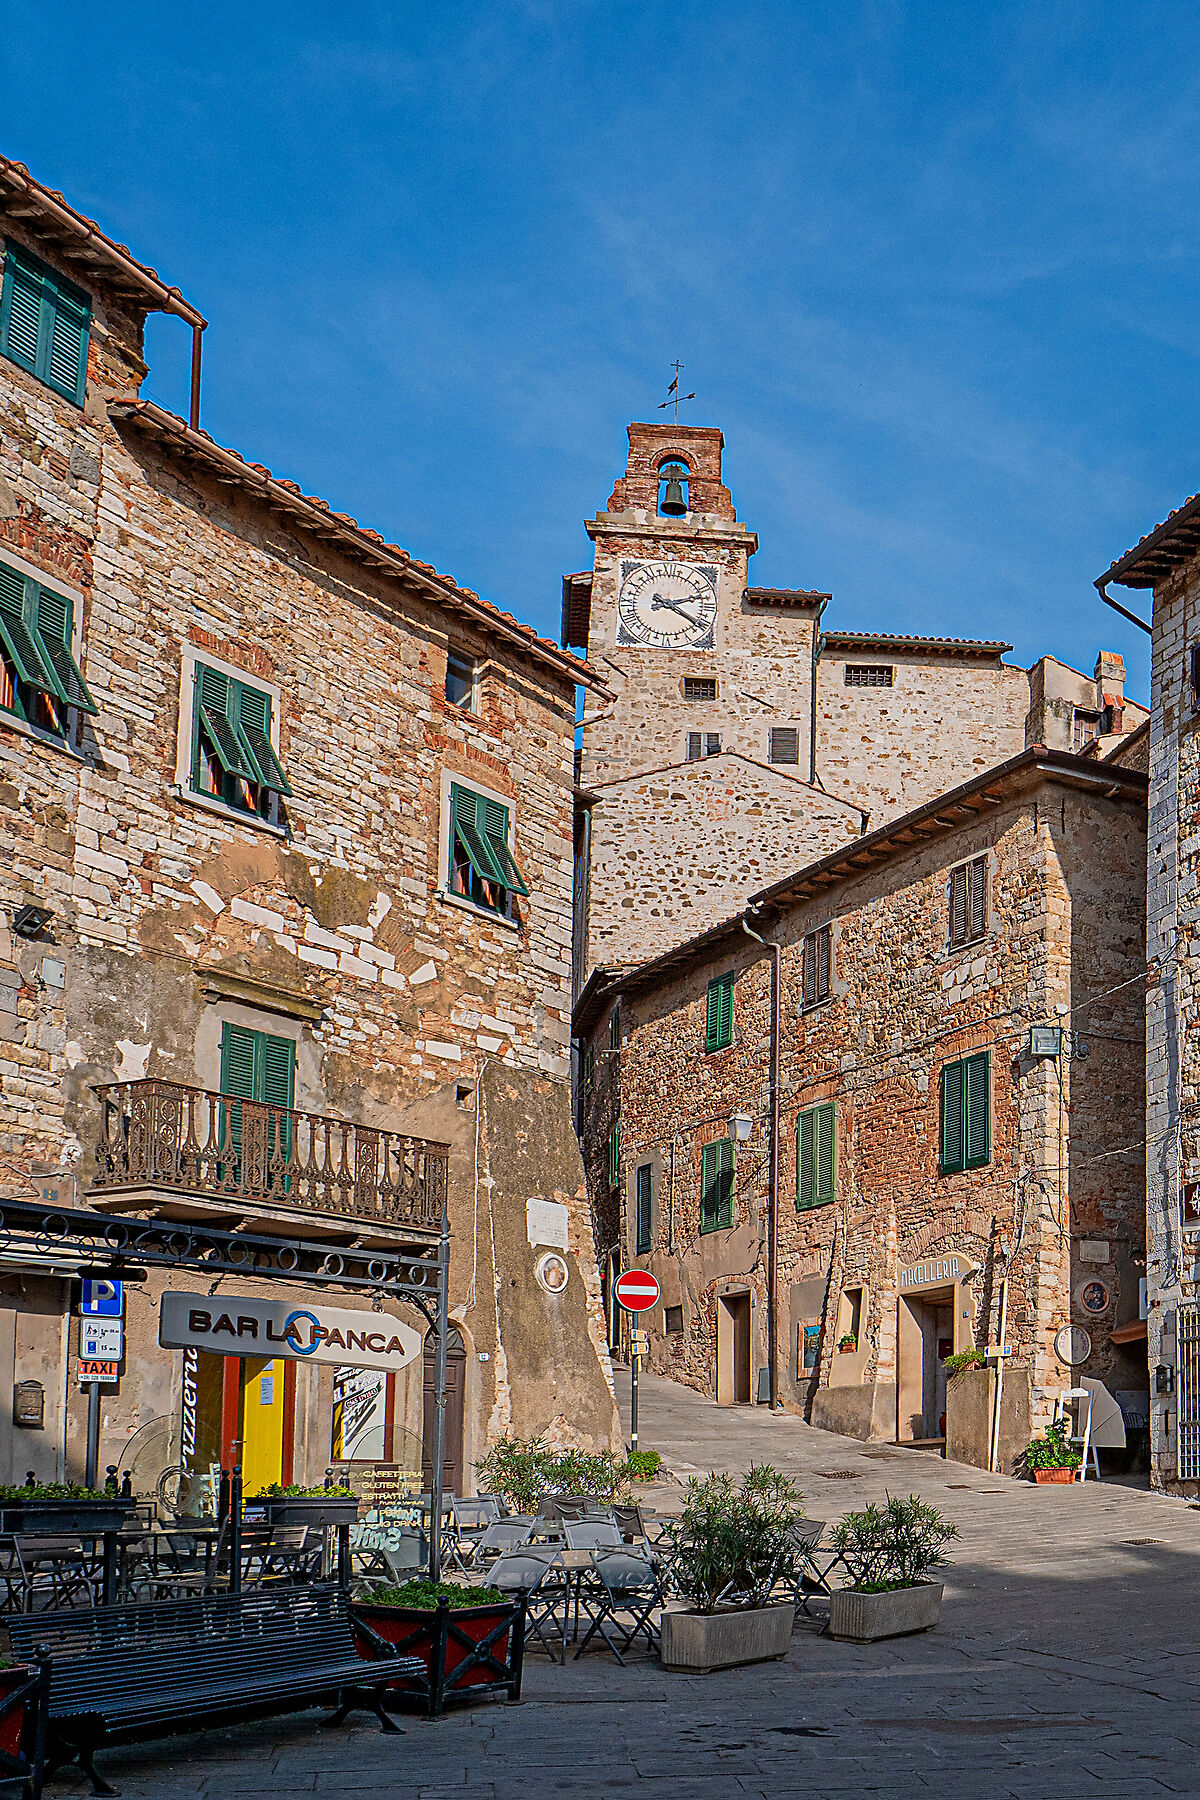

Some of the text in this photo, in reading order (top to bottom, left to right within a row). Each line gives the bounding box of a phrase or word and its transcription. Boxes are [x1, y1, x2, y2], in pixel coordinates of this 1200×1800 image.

[901, 1257, 959, 1287] MACELLERIA
[91, 1280, 116, 1311] P
[188, 1309, 406, 1356] BAR LA PANCA
[81, 1362, 113, 1374] TAXI
